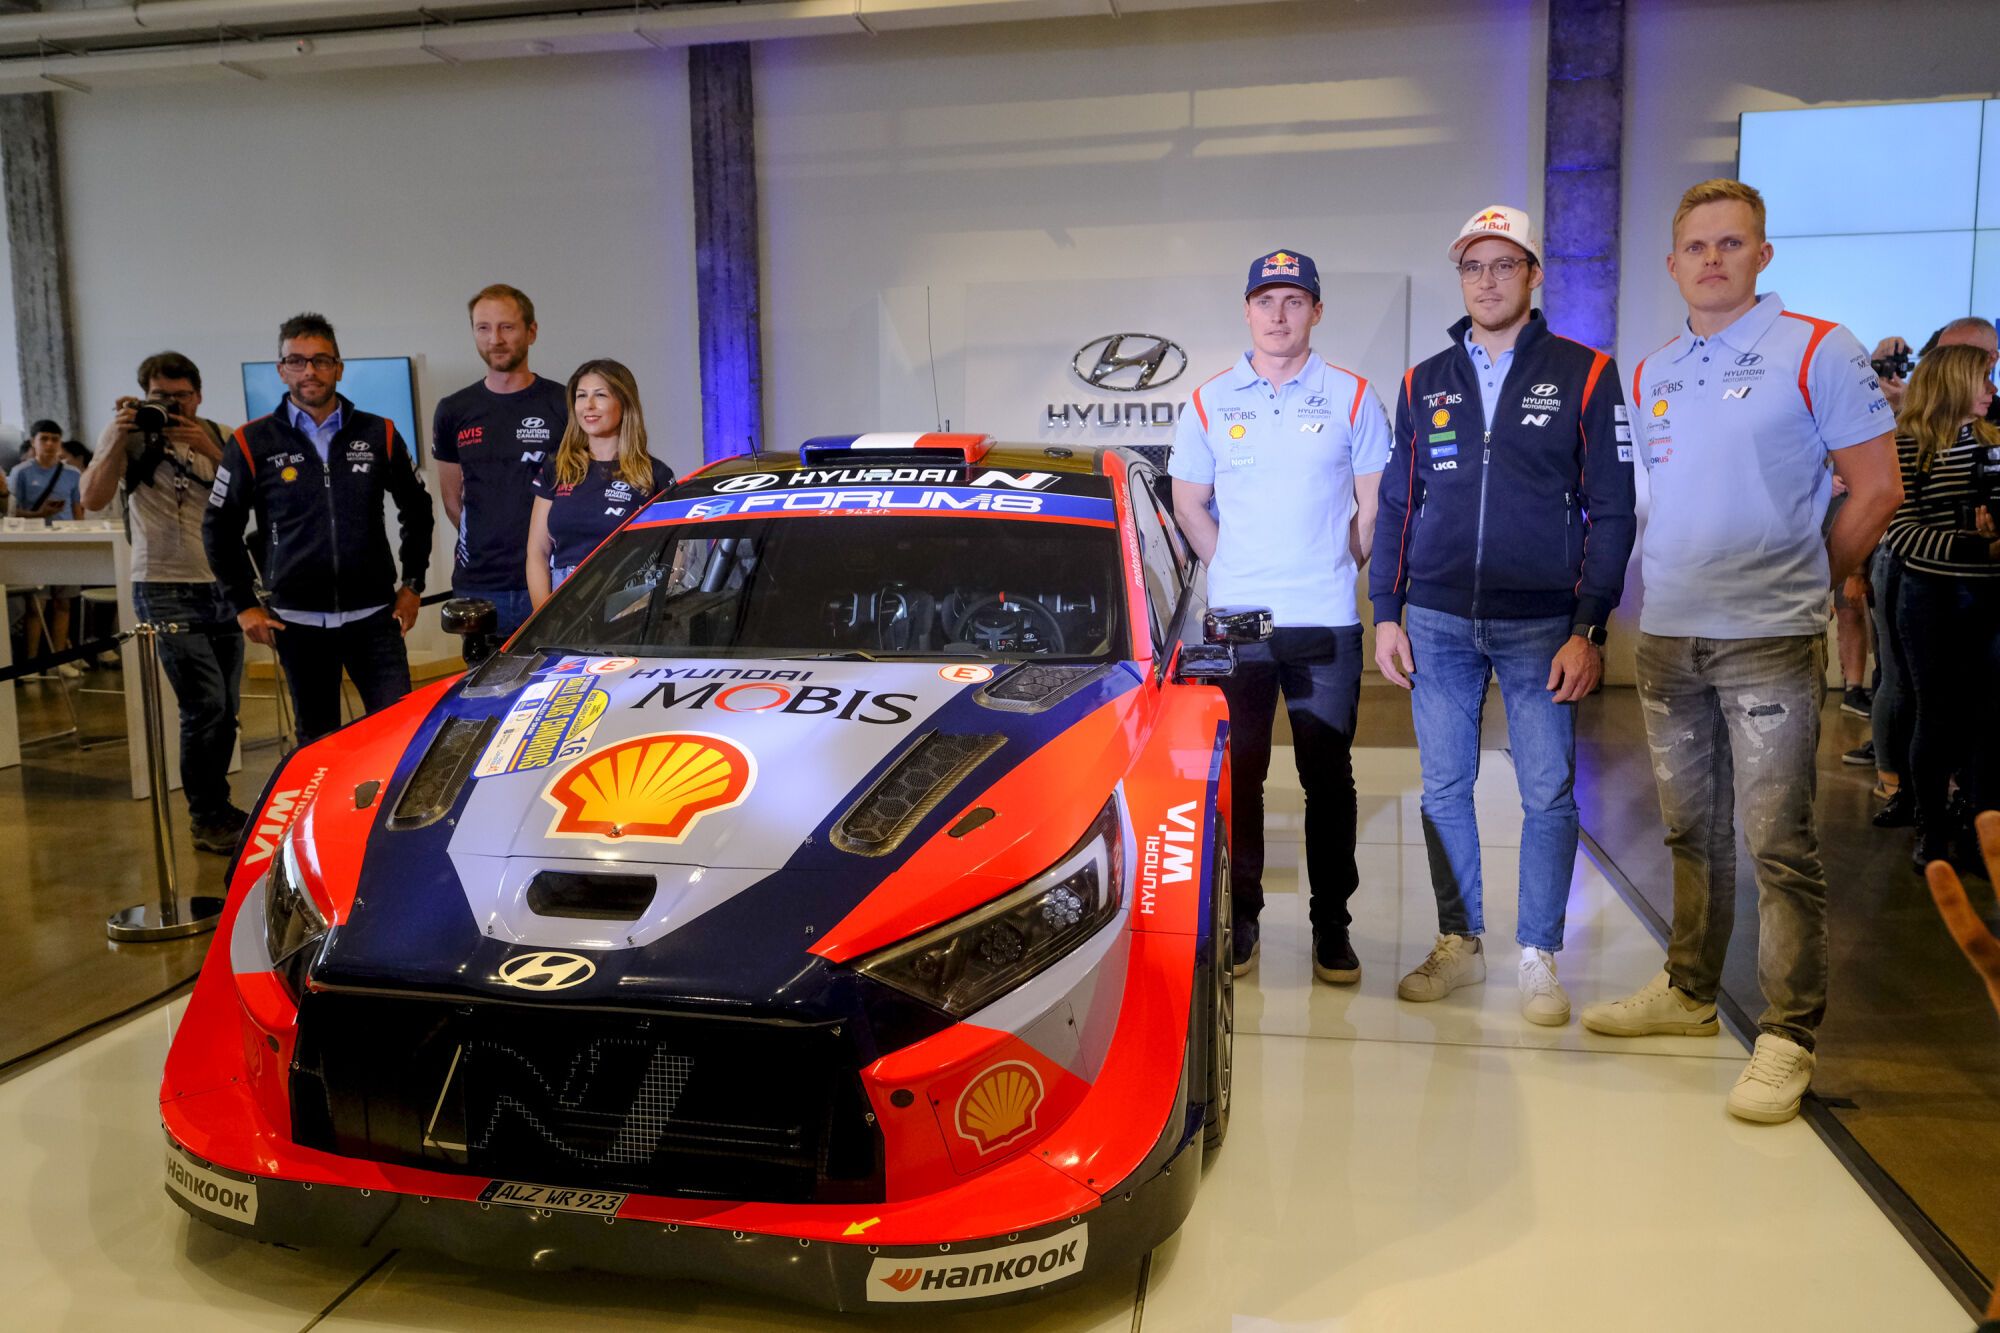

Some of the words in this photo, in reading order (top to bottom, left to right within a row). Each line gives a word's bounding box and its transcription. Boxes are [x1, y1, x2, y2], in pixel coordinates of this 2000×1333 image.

[1488, 221, 1511, 232] Bull
[1262, 267, 1280, 277] Red
[1281, 266, 1300, 276] Bull
[1724, 369, 1766, 377] HYUNDAI
[1652, 380, 1684, 398] MOBIS
[1429, 393, 1463, 408] MOBIS
[1523, 396, 1561, 407] HYUNDAI
[1522, 403, 1560, 413] MOTORSPORT
[1047, 402, 1187, 429] HYUND
[1224, 411, 1257, 422] MOBIS
[458, 427, 483, 440] AVIS
[275, 453, 305, 469] MBIS
[1433, 461, 1458, 472] LKQ
[738, 491, 1043, 513] FORUM8
[597, 659, 625, 671] E
[629, 668, 814, 682] HYUNDAI
[953, 666, 977, 679] E
[630, 682, 918, 724] MOBIS
[517, 717, 570, 770] CANARIAS
[559, 736, 587, 758] 16
[1140, 835, 1160, 915] HYUNDAI
[496, 1184, 544, 1202] ALZ
[545, 1189, 577, 1206] WR
[576, 1192, 622, 1211] 923
